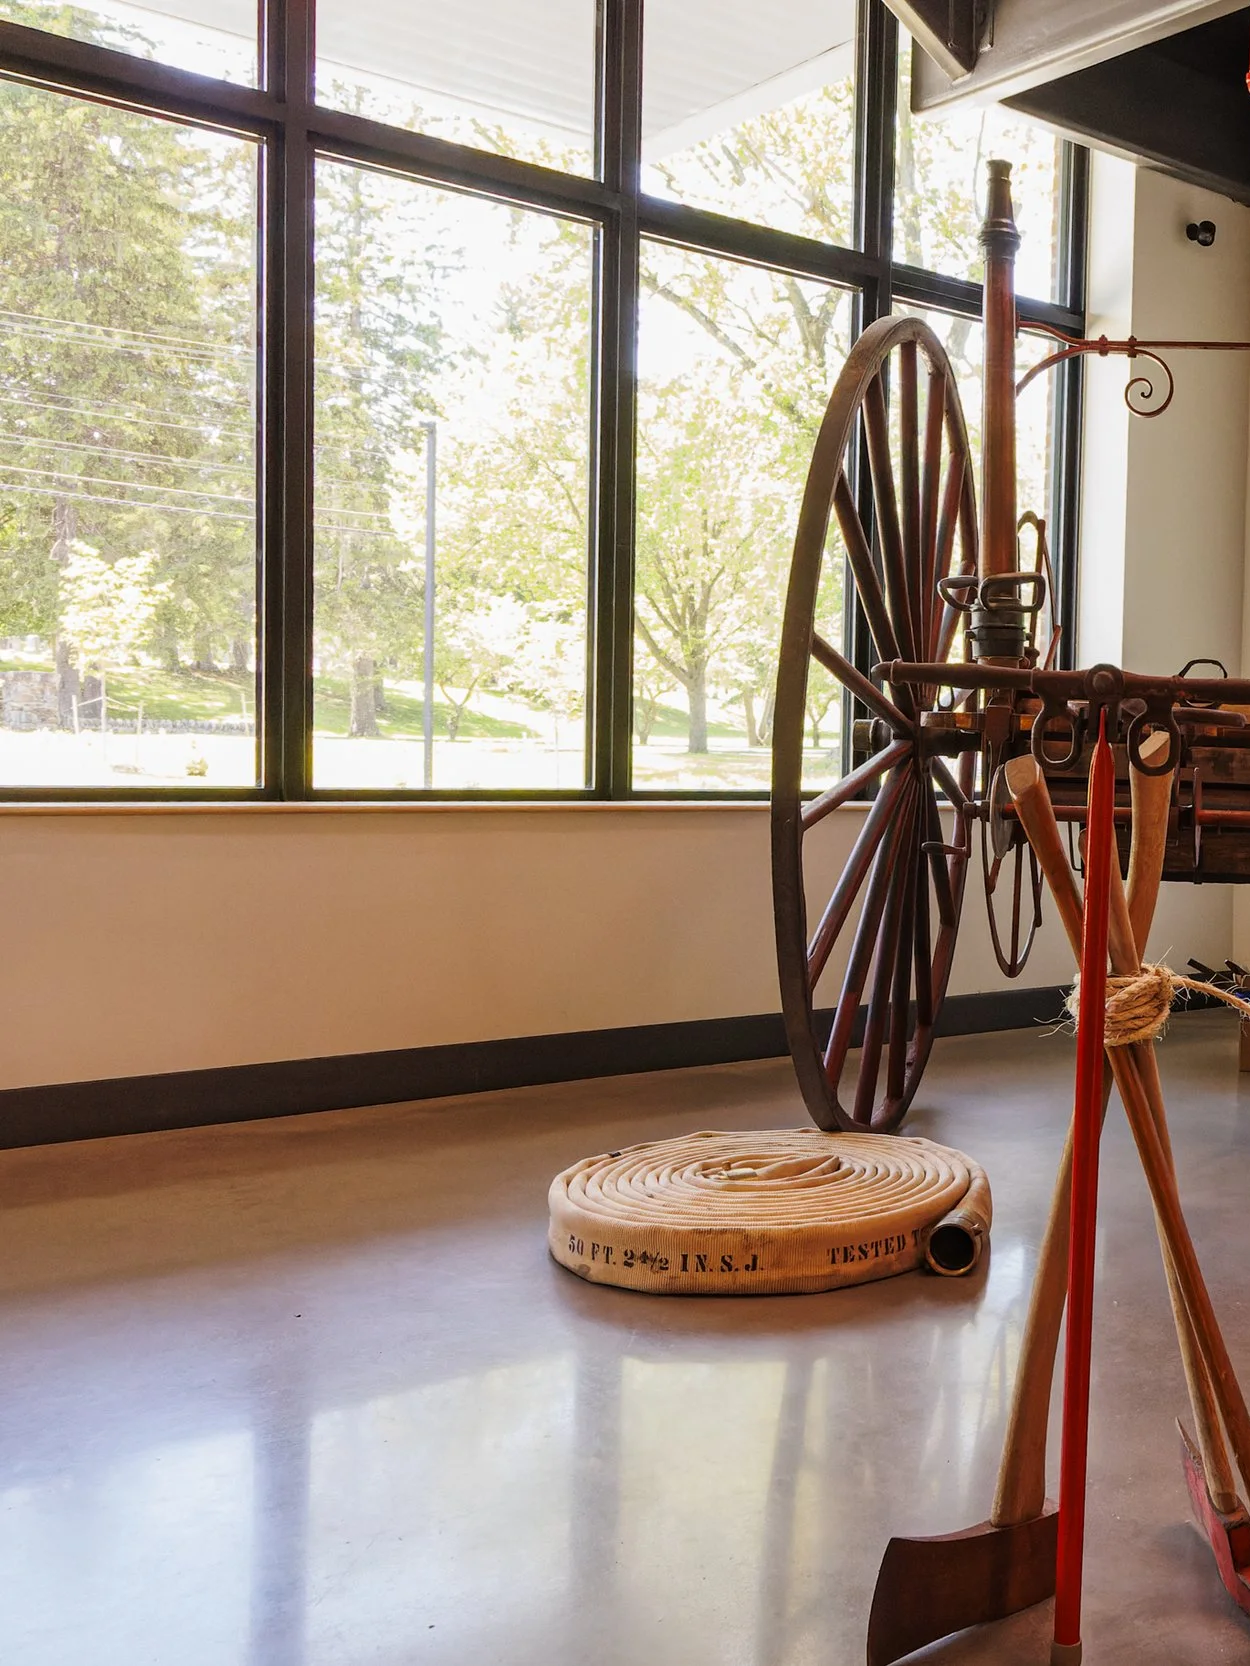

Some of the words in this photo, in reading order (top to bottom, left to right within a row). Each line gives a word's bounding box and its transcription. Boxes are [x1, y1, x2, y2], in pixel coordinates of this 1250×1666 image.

[569, 1234, 584, 1256] 50
[591, 1241, 617, 1265] FT.
[826, 1234, 907, 1265] TESTED
